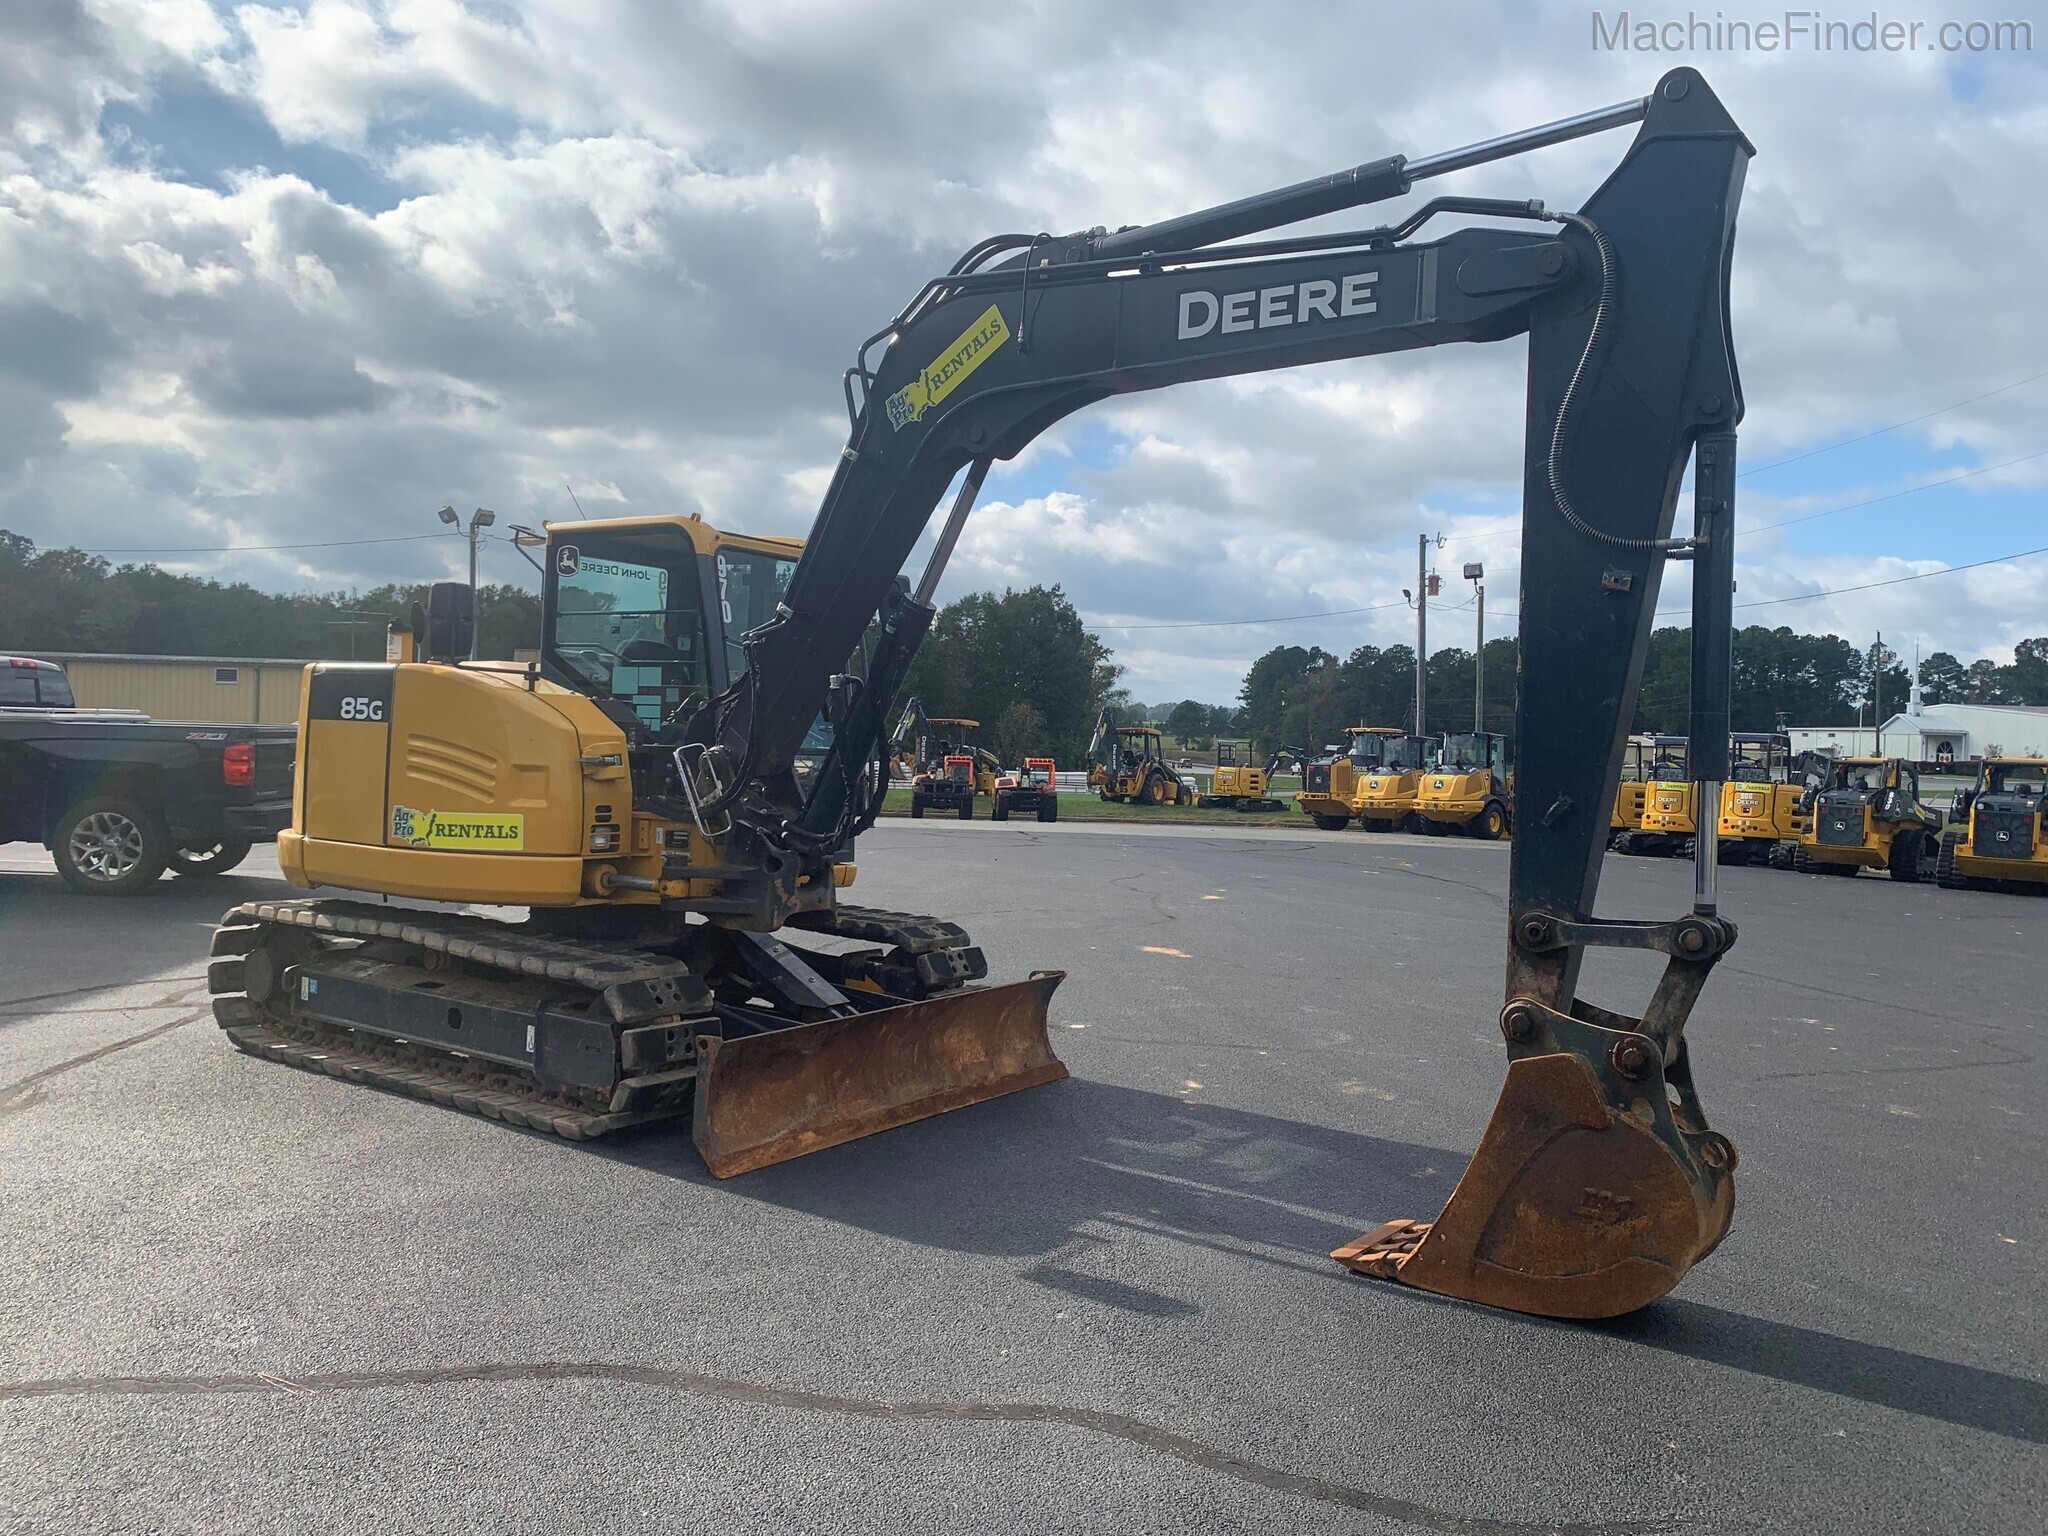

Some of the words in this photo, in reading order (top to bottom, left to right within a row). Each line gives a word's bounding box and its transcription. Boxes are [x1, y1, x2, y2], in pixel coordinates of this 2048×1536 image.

[1178, 271, 1379, 340] DEERE
[930, 318, 1001, 391] RENTALS
[892, 402, 915, 427] Pro
[717, 554, 732, 624] 970
[340, 696, 383, 720] 85G
[393, 821, 414, 836] Pro
[434, 822, 519, 840] RENTALS
